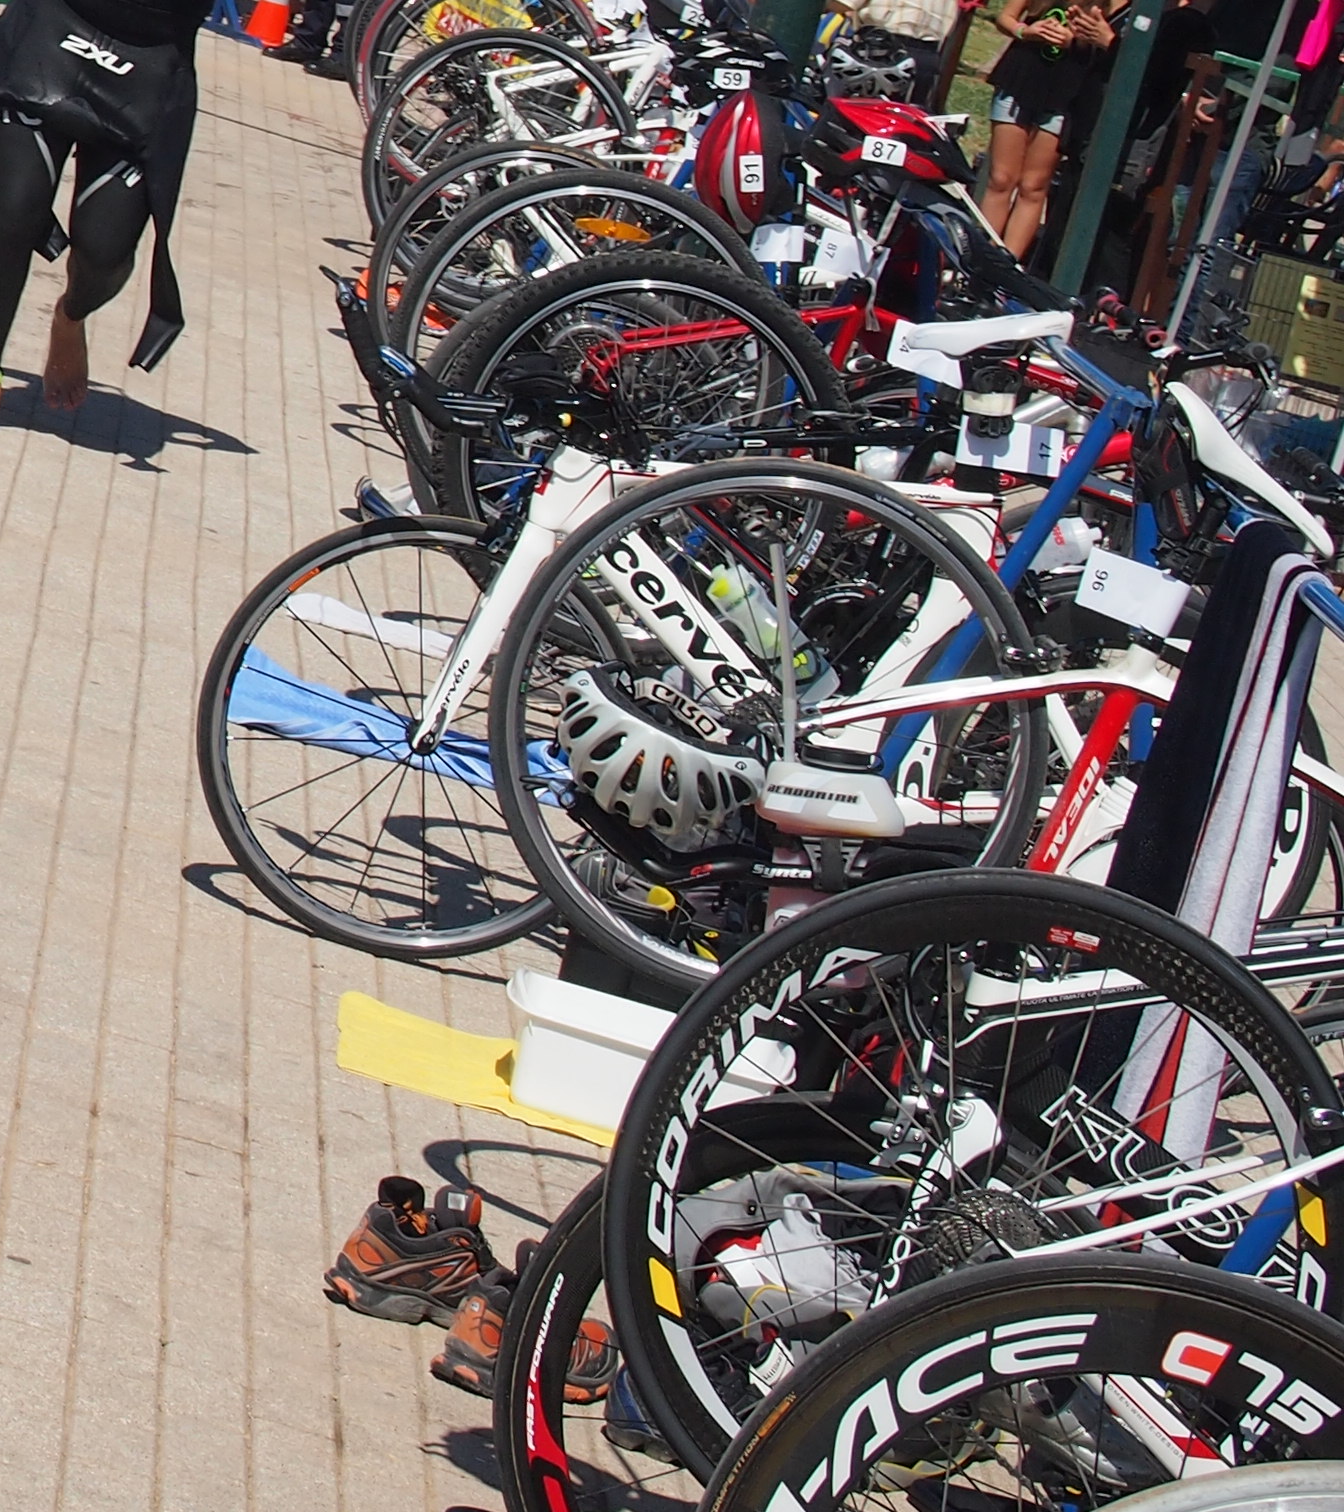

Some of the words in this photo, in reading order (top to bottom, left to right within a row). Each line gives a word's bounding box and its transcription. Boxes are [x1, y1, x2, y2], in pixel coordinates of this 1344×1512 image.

[59, 33, 134, 76] 2XU
[722, 72, 743, 86] 59
[743, 160, 760, 184] 91
[871, 141, 896, 161] 87
[646, 945, 883, 1255] CORIMA
[529, 1271, 565, 1387] FORWARD
[525, 1392, 539, 1453] FAST
